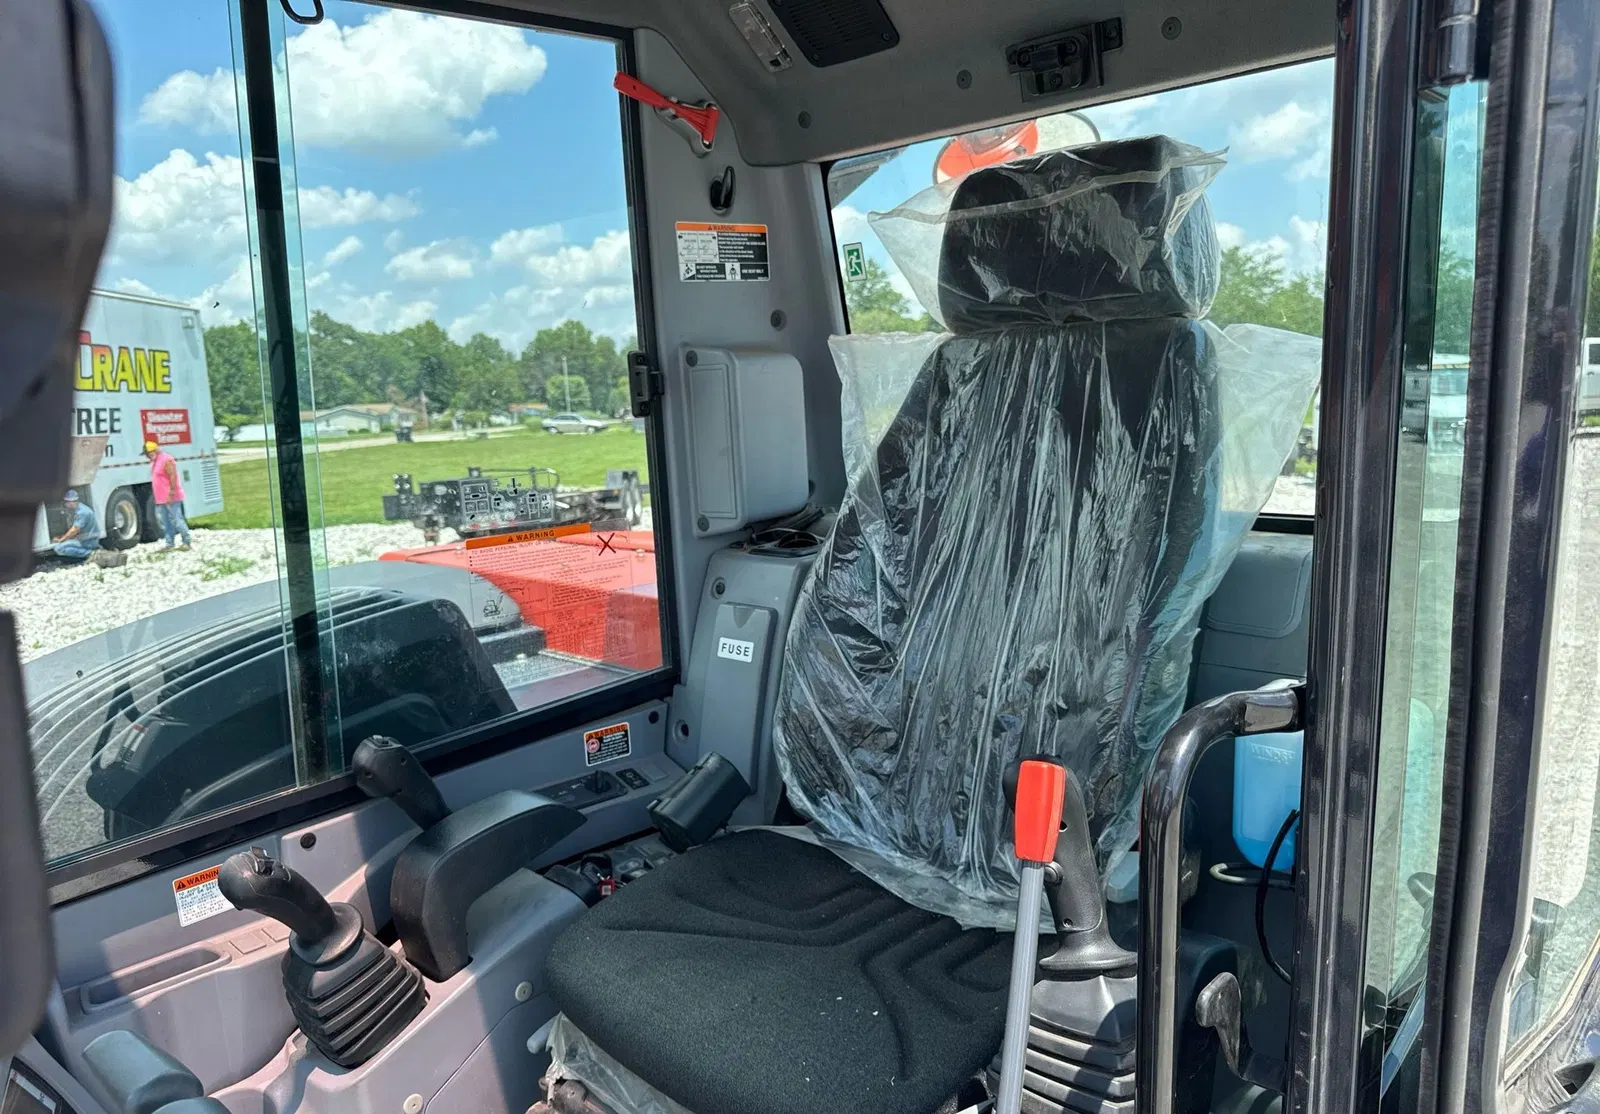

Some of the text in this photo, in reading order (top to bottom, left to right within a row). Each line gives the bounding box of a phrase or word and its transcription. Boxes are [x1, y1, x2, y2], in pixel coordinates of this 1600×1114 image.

[73, 408, 121, 435] REE
[515, 529, 555, 541] WARNING
[721, 643, 750, 657] FUSE
[186, 869, 219, 886] WARNIN
